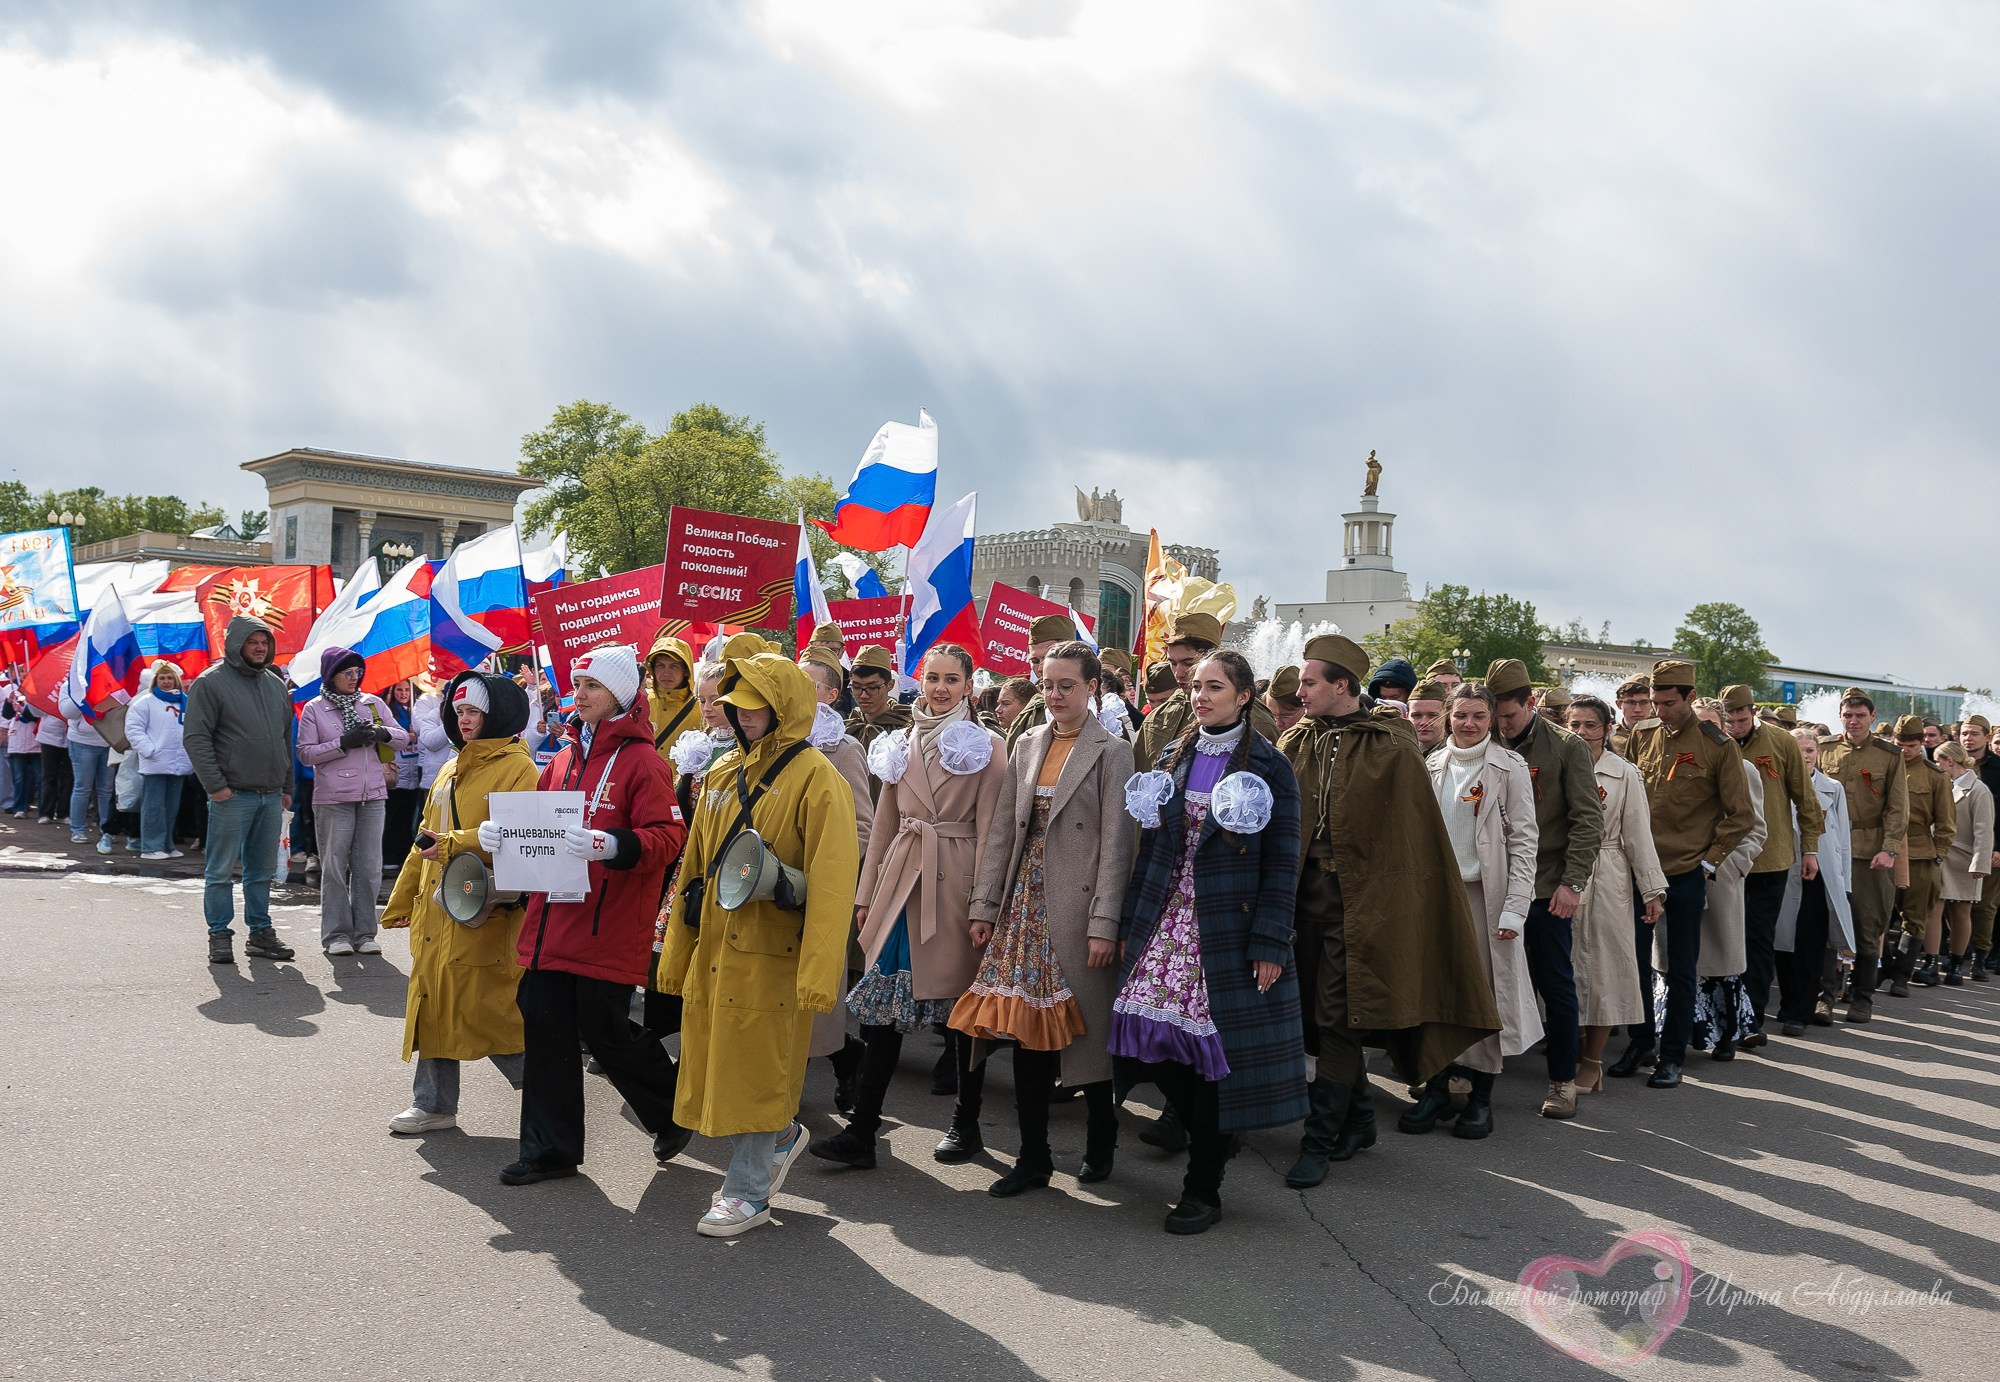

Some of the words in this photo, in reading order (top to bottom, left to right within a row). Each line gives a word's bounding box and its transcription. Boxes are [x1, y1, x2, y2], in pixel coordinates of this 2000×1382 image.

[359, 494, 468, 512] АЗЕРБАЙДЖАН
[684, 523, 735, 541] Великая
[735, 530, 779, 548] Победа
[682, 543, 735, 559] гордость
[680, 561, 748, 577] поколений!
[677, 581, 743, 602] РОССИЯ
[554, 602, 579, 615] Мы
[580, 587, 641, 609] гордимся
[559, 608, 621, 632] подвигом
[622, 599, 661, 616] наших
[833, 618, 867, 629] Никто
[869, 617, 882, 625] не
[563, 623, 622, 649] предков!
[842, 632, 867, 642] ичто
[869, 631, 882, 639] не
[584, 800, 616, 810] ВООНТЁР
[500, 827, 567, 840] анцевальна
[520, 845, 555, 858] группа
